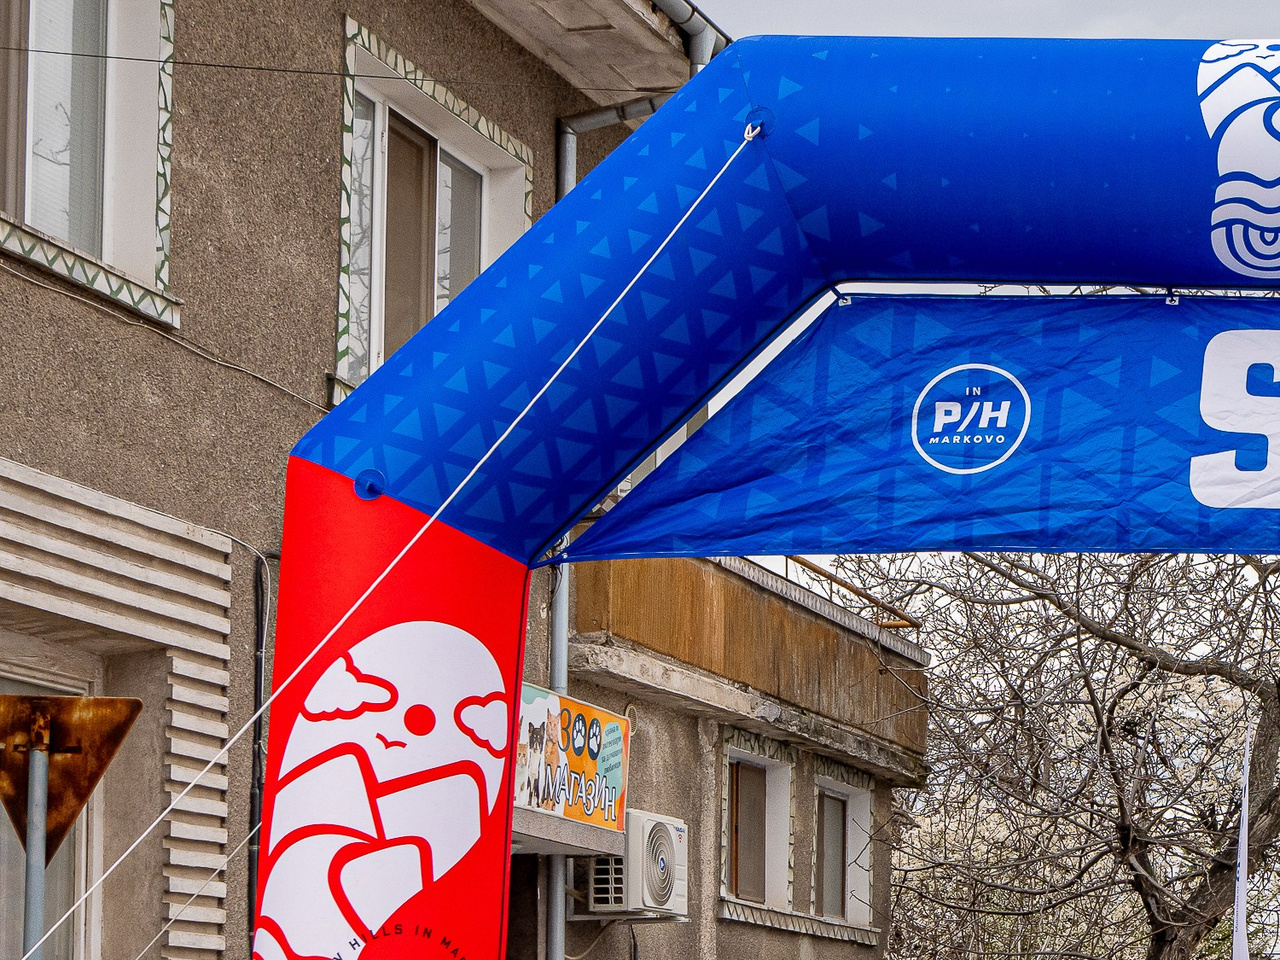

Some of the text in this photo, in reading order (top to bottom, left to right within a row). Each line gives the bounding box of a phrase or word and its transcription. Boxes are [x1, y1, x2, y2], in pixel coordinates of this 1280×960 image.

[965, 386, 982, 396] IN
[933, 400, 1011, 433] P/H
[929, 434, 1006, 445] MARKOVO
[544, 763, 617, 822] МАГАЗИН
[348, 923, 403, 951] HILLS
[414, 924, 433, 939] IN
